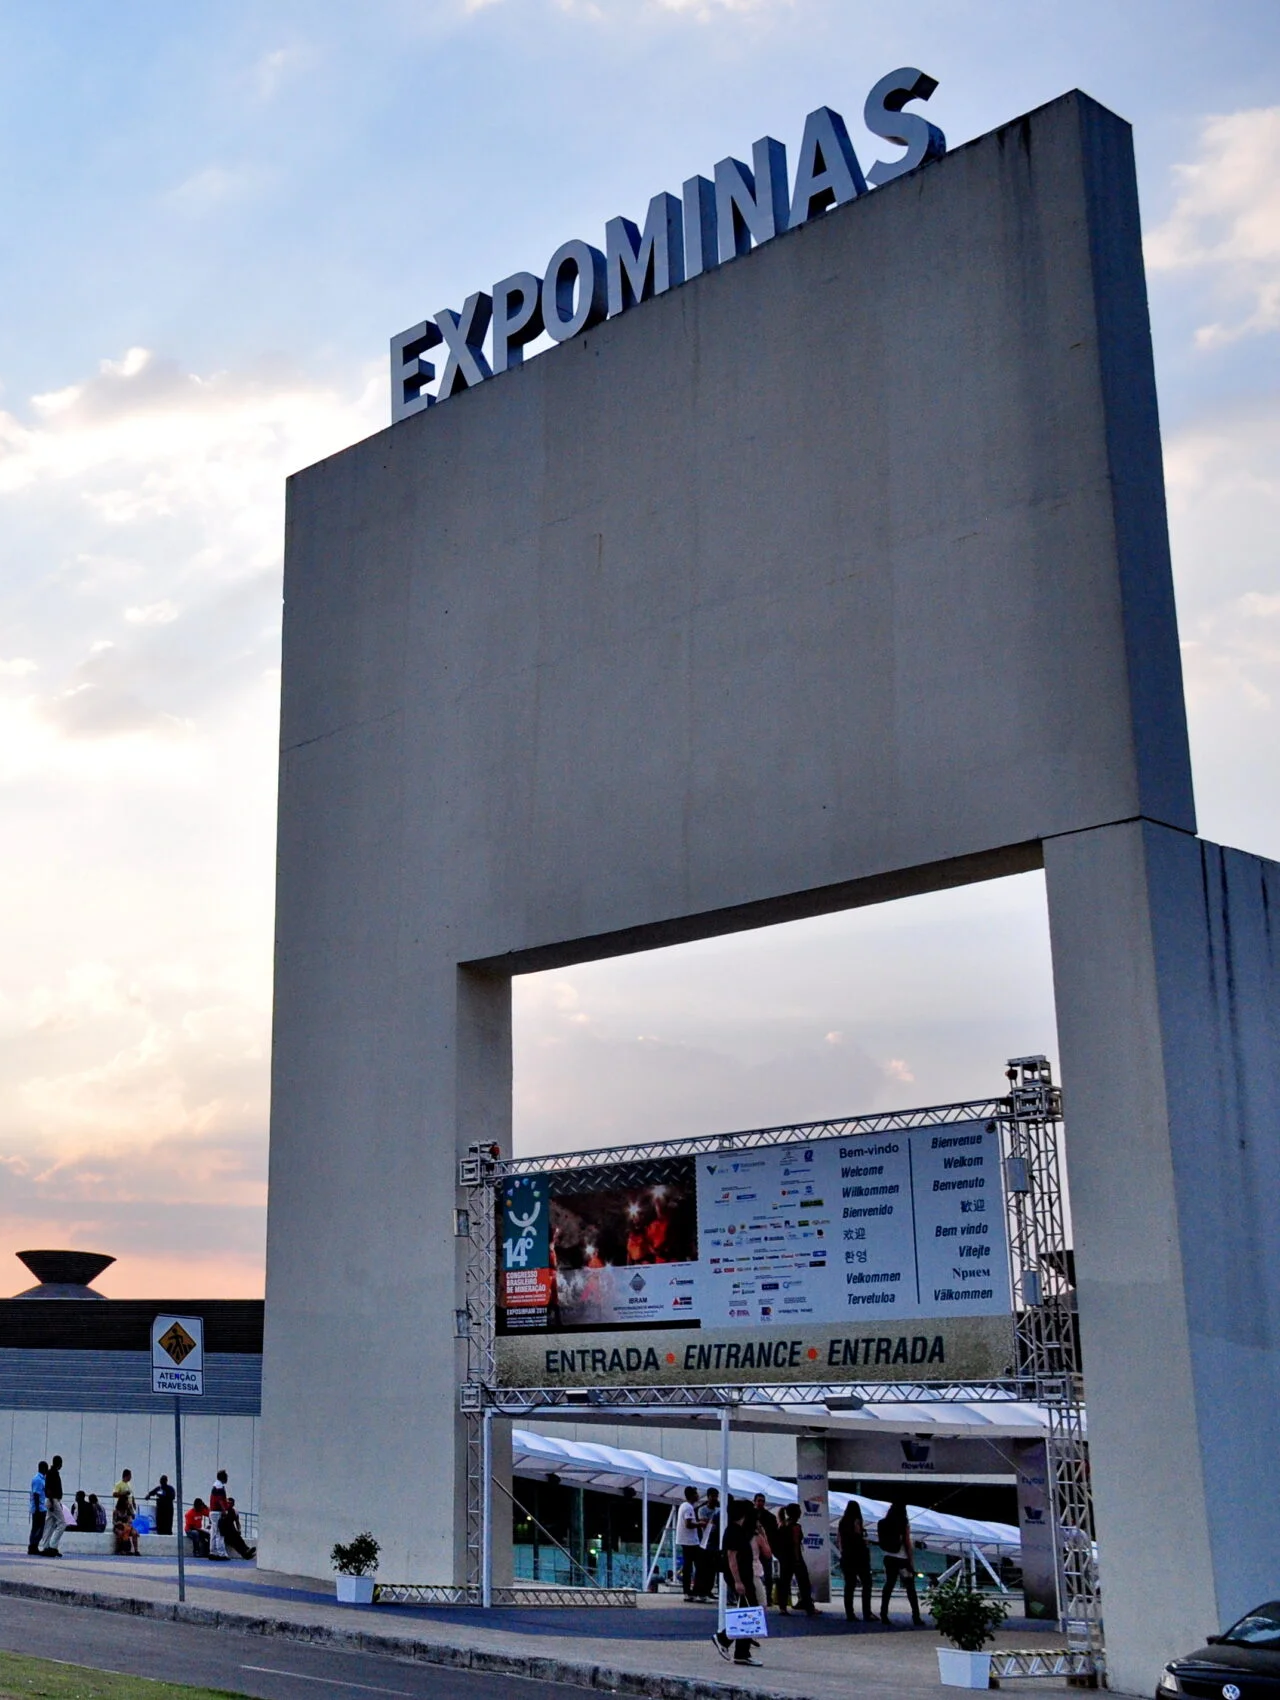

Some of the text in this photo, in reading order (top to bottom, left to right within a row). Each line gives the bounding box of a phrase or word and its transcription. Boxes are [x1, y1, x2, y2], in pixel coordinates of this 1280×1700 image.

[390, 66, 946, 425] EXPOMINAS
[931, 1134, 982, 1149] Bienvenue
[839, 1143, 899, 1158] Bem-vindo
[943, 1156, 983, 1169] Welkom
[841, 1165, 883, 1178] Welcome
[842, 1184, 899, 1198] Willkommen
[932, 1177, 985, 1191] Benvenuto
[842, 1204, 893, 1219] Bienvenido
[935, 1223, 988, 1237] Bem vindo
[958, 1245, 990, 1259] Vitejte
[506, 1270, 538, 1279] CONGRESSO
[846, 1272, 901, 1285] Velkommen
[847, 1292, 895, 1305] Tervetuloa
[934, 1288, 993, 1302] Välkommen
[546, 1335, 946, 1373] ENTRADA ENTRANCE ENTRADA
[159, 1372, 197, 1382] ATENÇÃO
[157, 1381, 199, 1391] TRAVESSIA
